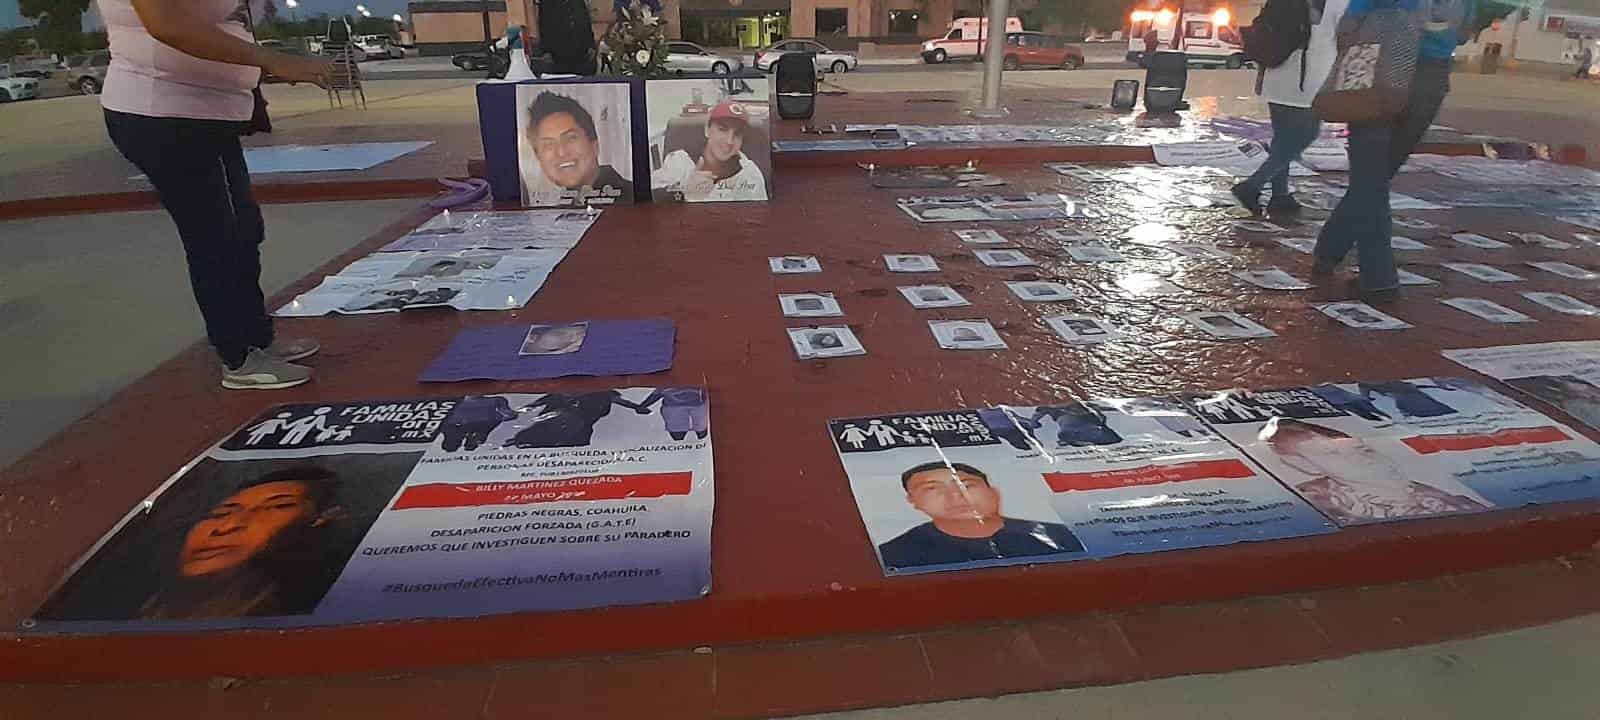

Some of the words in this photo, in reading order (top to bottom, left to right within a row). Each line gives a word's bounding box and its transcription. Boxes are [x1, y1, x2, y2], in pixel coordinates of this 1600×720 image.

[340, 401, 456, 416] FAMILIAS
[351, 410, 449, 423] UNIDAS
[891, 413, 979, 425] FAMILIAS
[395, 420, 441, 433] .org
[390, 429, 434, 439] .mx
[619, 443, 693, 454] ALIZACION
[506, 480, 566, 491] MARTINEZ
[568, 477, 623, 486] QUEZADA
[477, 510, 528, 520] PIEDRAS
[530, 508, 583, 518] NEGRAS,
[586, 504, 648, 516] COAHUILA
[431, 524, 522, 538] DESAPARICION
[524, 521, 583, 530] FORZADA
[362, 543, 437, 556] QUEREMOS
[440, 543, 468, 553] QUE
[472, 536, 556, 550] INVESTIGUEN
[559, 534, 600, 544] SOBRE
[603, 533, 621, 543] SU
[624, 530, 692, 540] PARADERO
